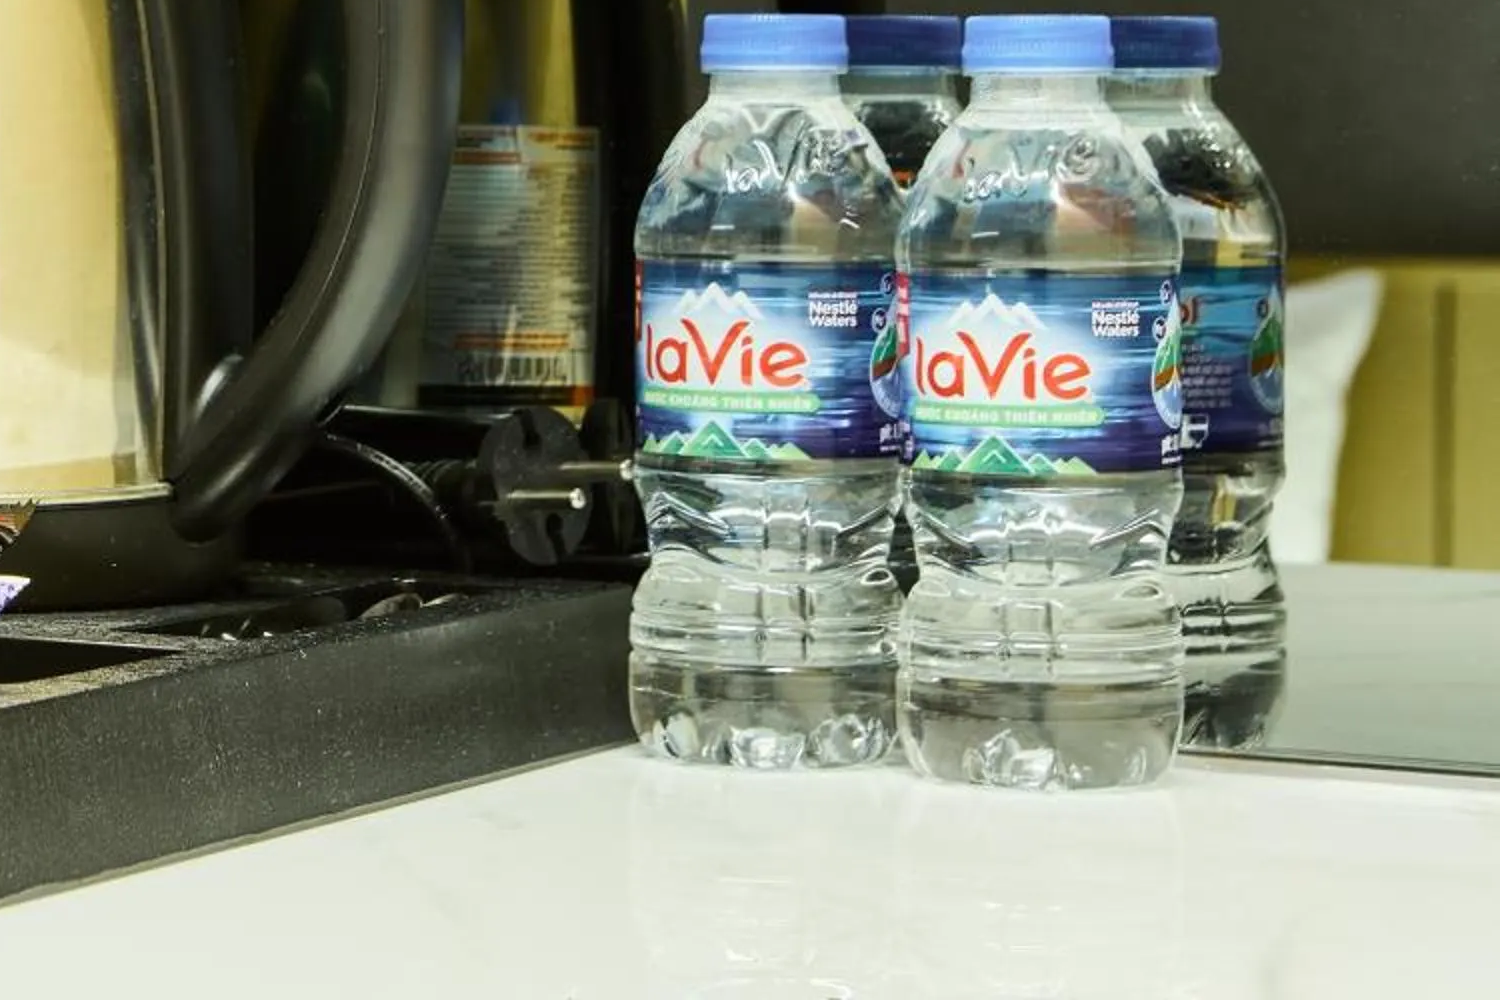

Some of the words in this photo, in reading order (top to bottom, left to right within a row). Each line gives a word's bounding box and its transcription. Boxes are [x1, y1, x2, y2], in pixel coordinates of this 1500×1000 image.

[810, 316, 857, 327] Waters
[1092, 325, 1140, 337] Waters
[646, 317, 807, 388] laVie
[915, 330, 1091, 400] laVie
